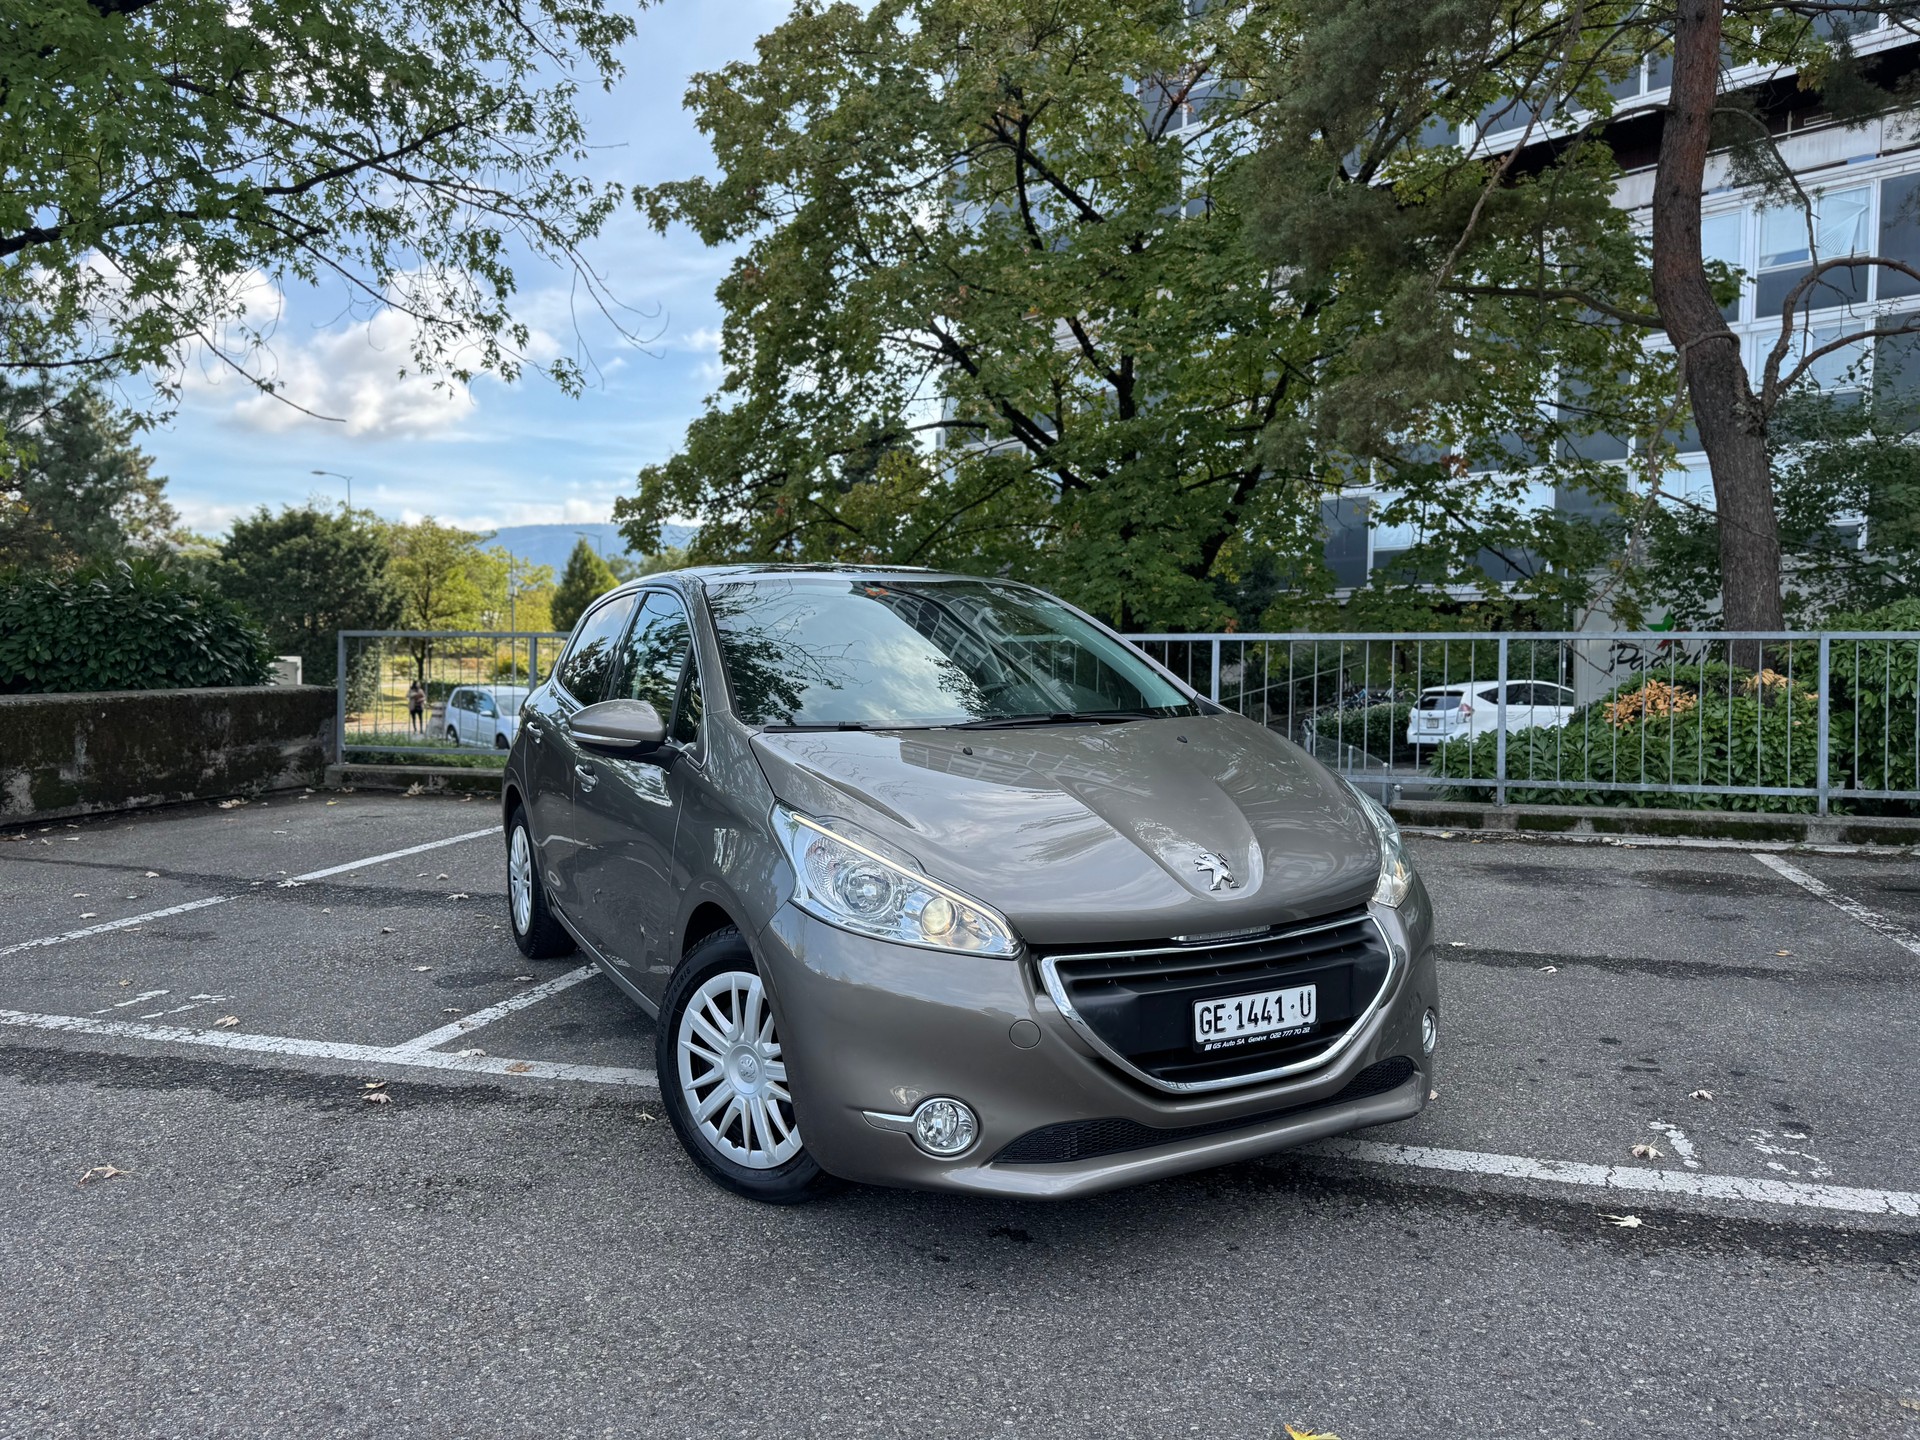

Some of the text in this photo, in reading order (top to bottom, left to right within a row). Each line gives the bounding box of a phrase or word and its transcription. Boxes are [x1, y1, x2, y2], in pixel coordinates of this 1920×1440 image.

[1200, 1003, 1226, 1035] GE
[1235, 995, 1285, 1030] 1441
[1222, 1040, 1236, 1048] Auto
[1236, 1038, 1245, 1046] SA
